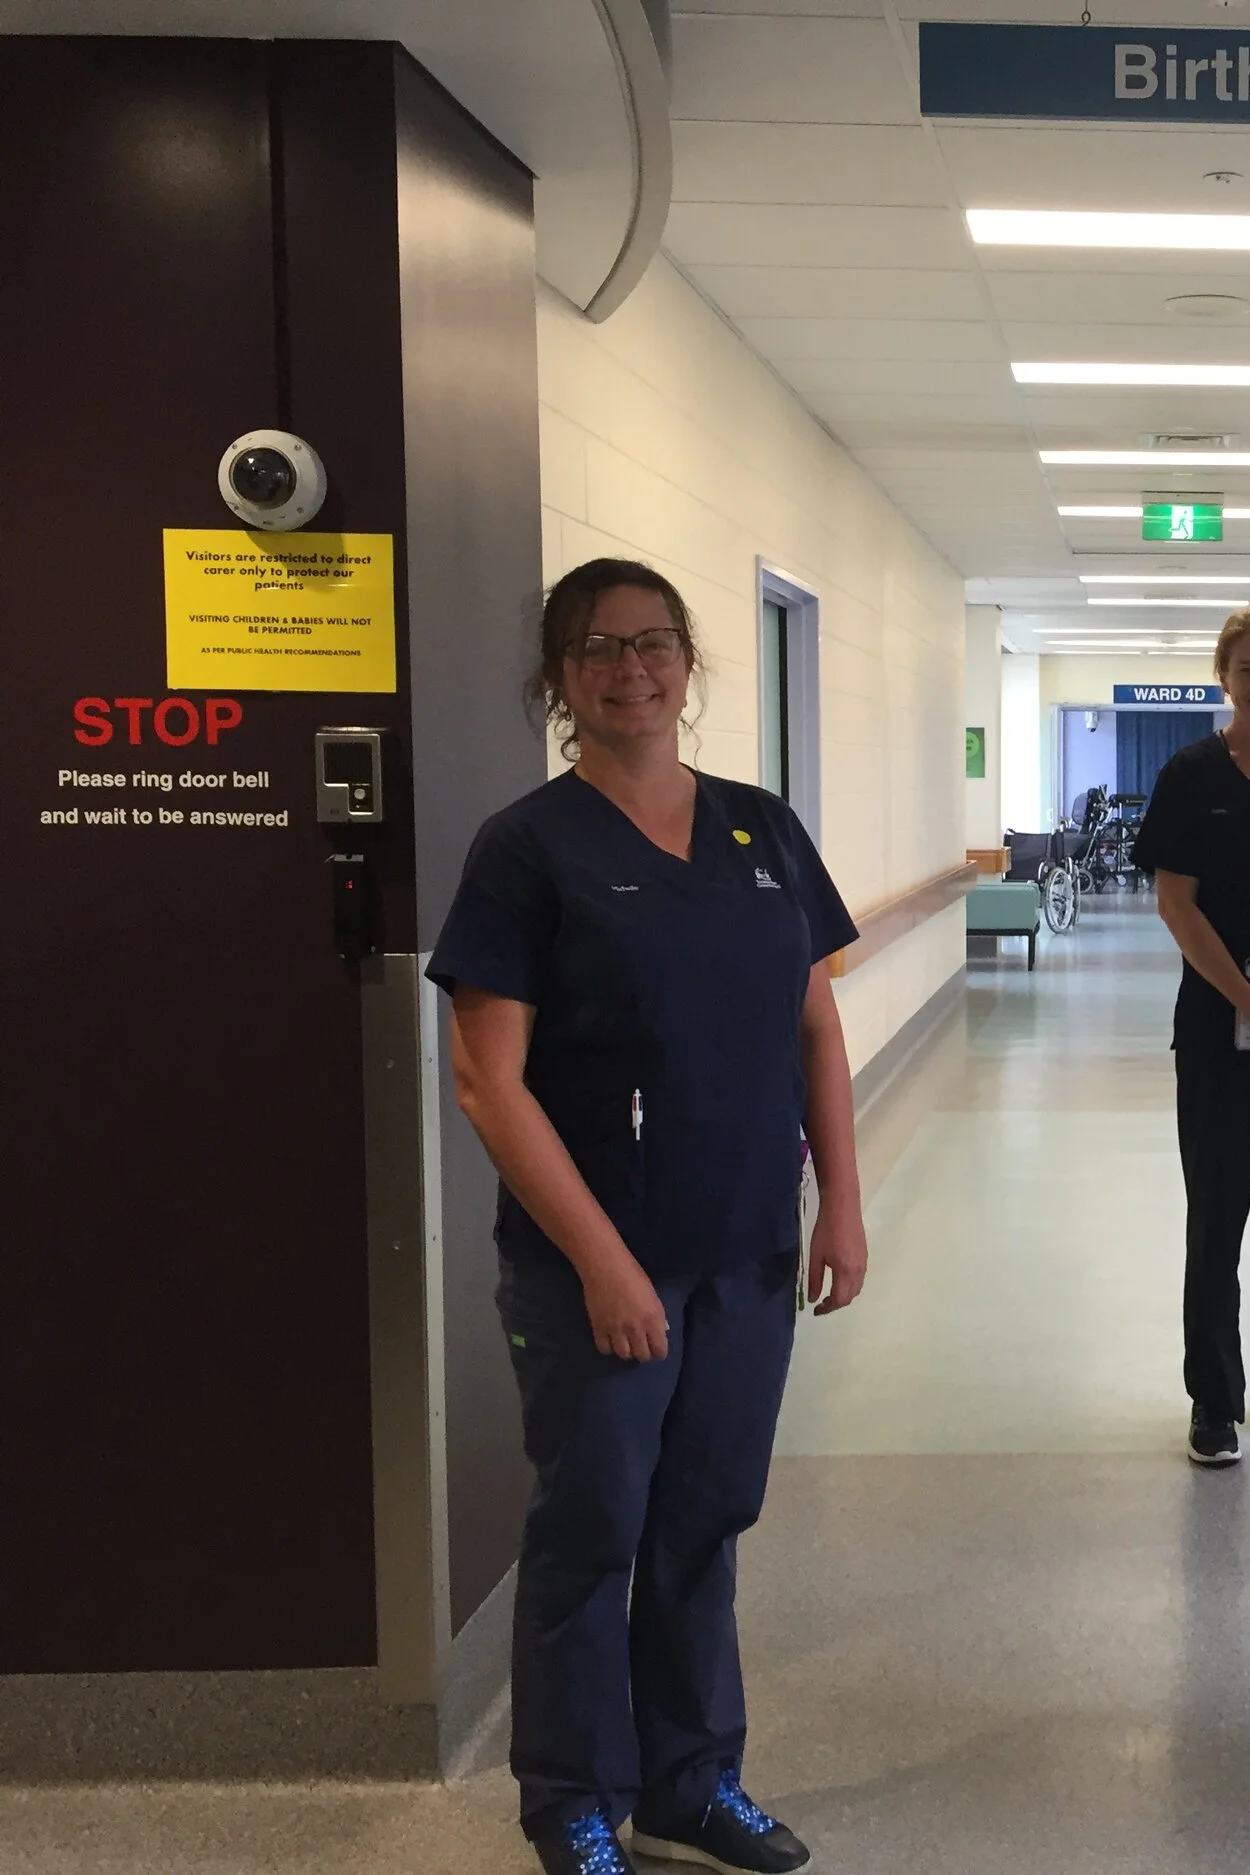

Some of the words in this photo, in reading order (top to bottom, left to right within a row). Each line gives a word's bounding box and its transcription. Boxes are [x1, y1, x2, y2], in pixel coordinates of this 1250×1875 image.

[185, 550, 232, 562] Visitors
[235, 554, 256, 563] are
[260, 552, 318, 564] restricted
[321, 554, 334, 564] to
[337, 553, 372, 565] direct
[204, 567, 236, 576] carer
[239, 566, 267, 578] only
[270, 567, 283, 577] to
[287, 568, 330, 579] protect
[333, 569, 354, 578] our
[254, 581, 304, 592] patients
[189, 615, 230, 623] VISITING
[233, 616, 280, 624] CHILDREN
[282, 617, 289, 625] &
[291, 617, 323, 625] BABIES
[326, 617, 349, 626] WILL
[351, 618, 372, 626] NOT
[248, 626, 259, 634] BE
[262, 626, 312, 635] PERMITTED
[284, 649, 362, 657] RECOMMENDATIONS
[1133, 687, 1182, 701] WARD
[1185, 687, 1206, 701] 4D
[73, 696, 243, 747] STOP
[58, 769, 126, 788] Please
[132, 771, 173, 792] ring
[179, 770, 227, 788] door
[233, 771, 269, 788] bell
[40, 808, 78, 825] and
[84, 808, 126, 825] wait
[132, 808, 152, 825] to
[158, 808, 184, 825] be
[190, 810, 288, 827] answered
